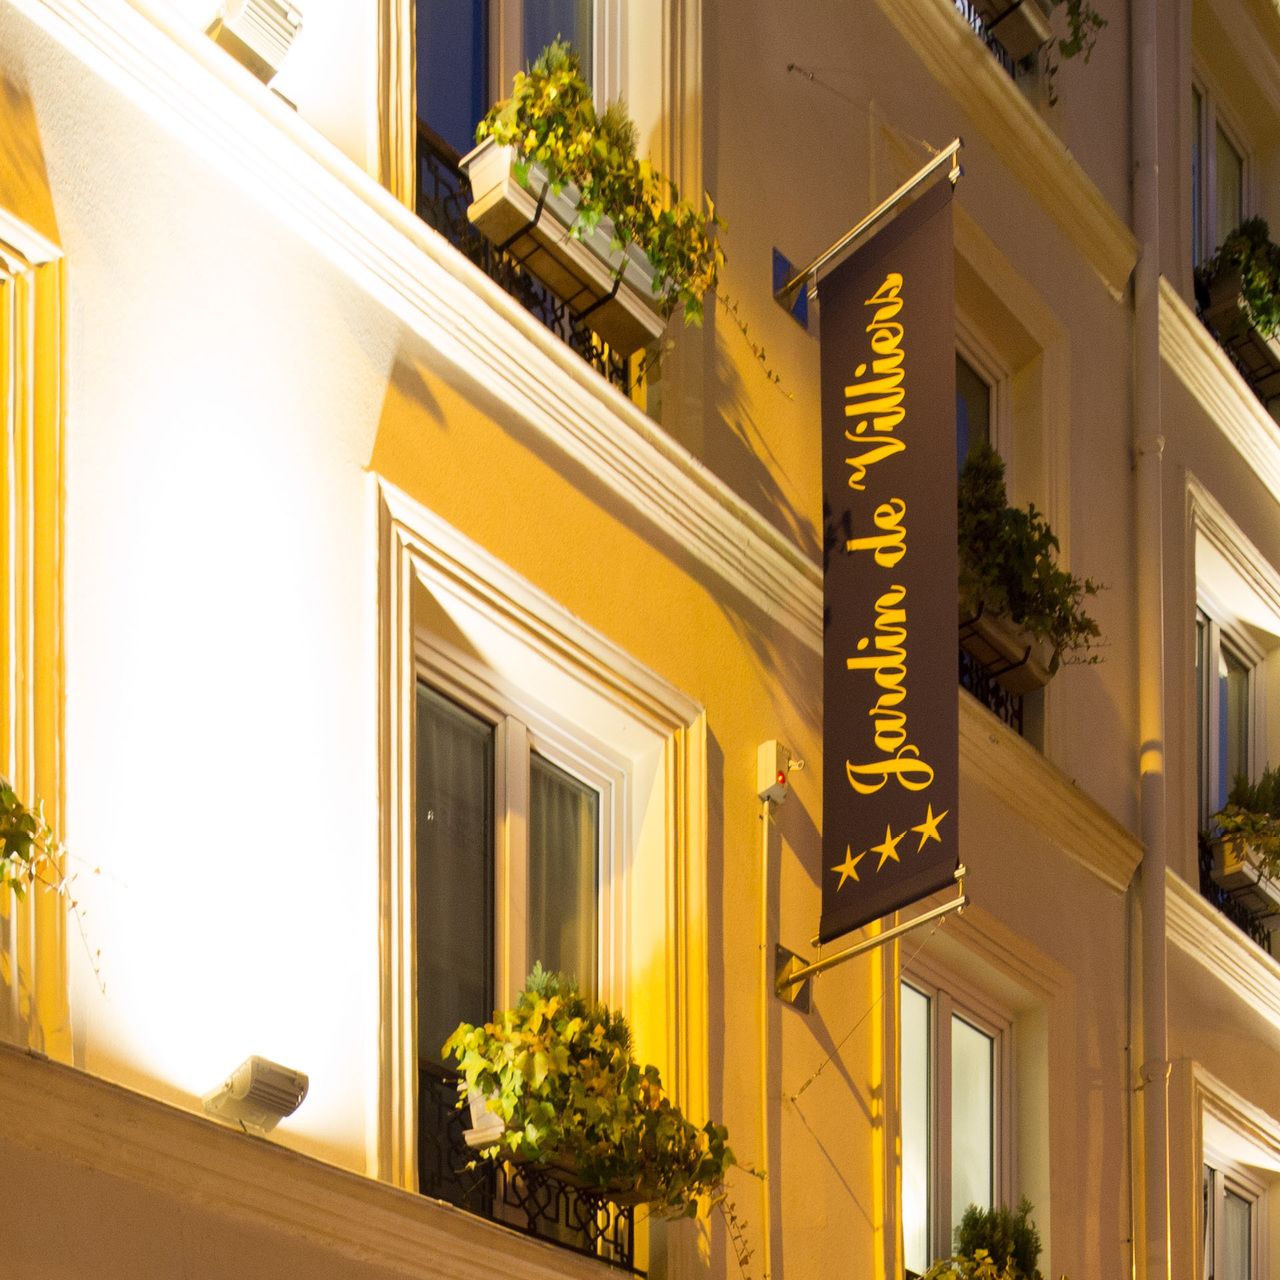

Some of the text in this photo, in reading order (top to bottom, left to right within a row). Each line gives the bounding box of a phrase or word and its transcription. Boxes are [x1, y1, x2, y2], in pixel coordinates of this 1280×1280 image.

[844, 272, 935, 795] Jardin de Villiers
